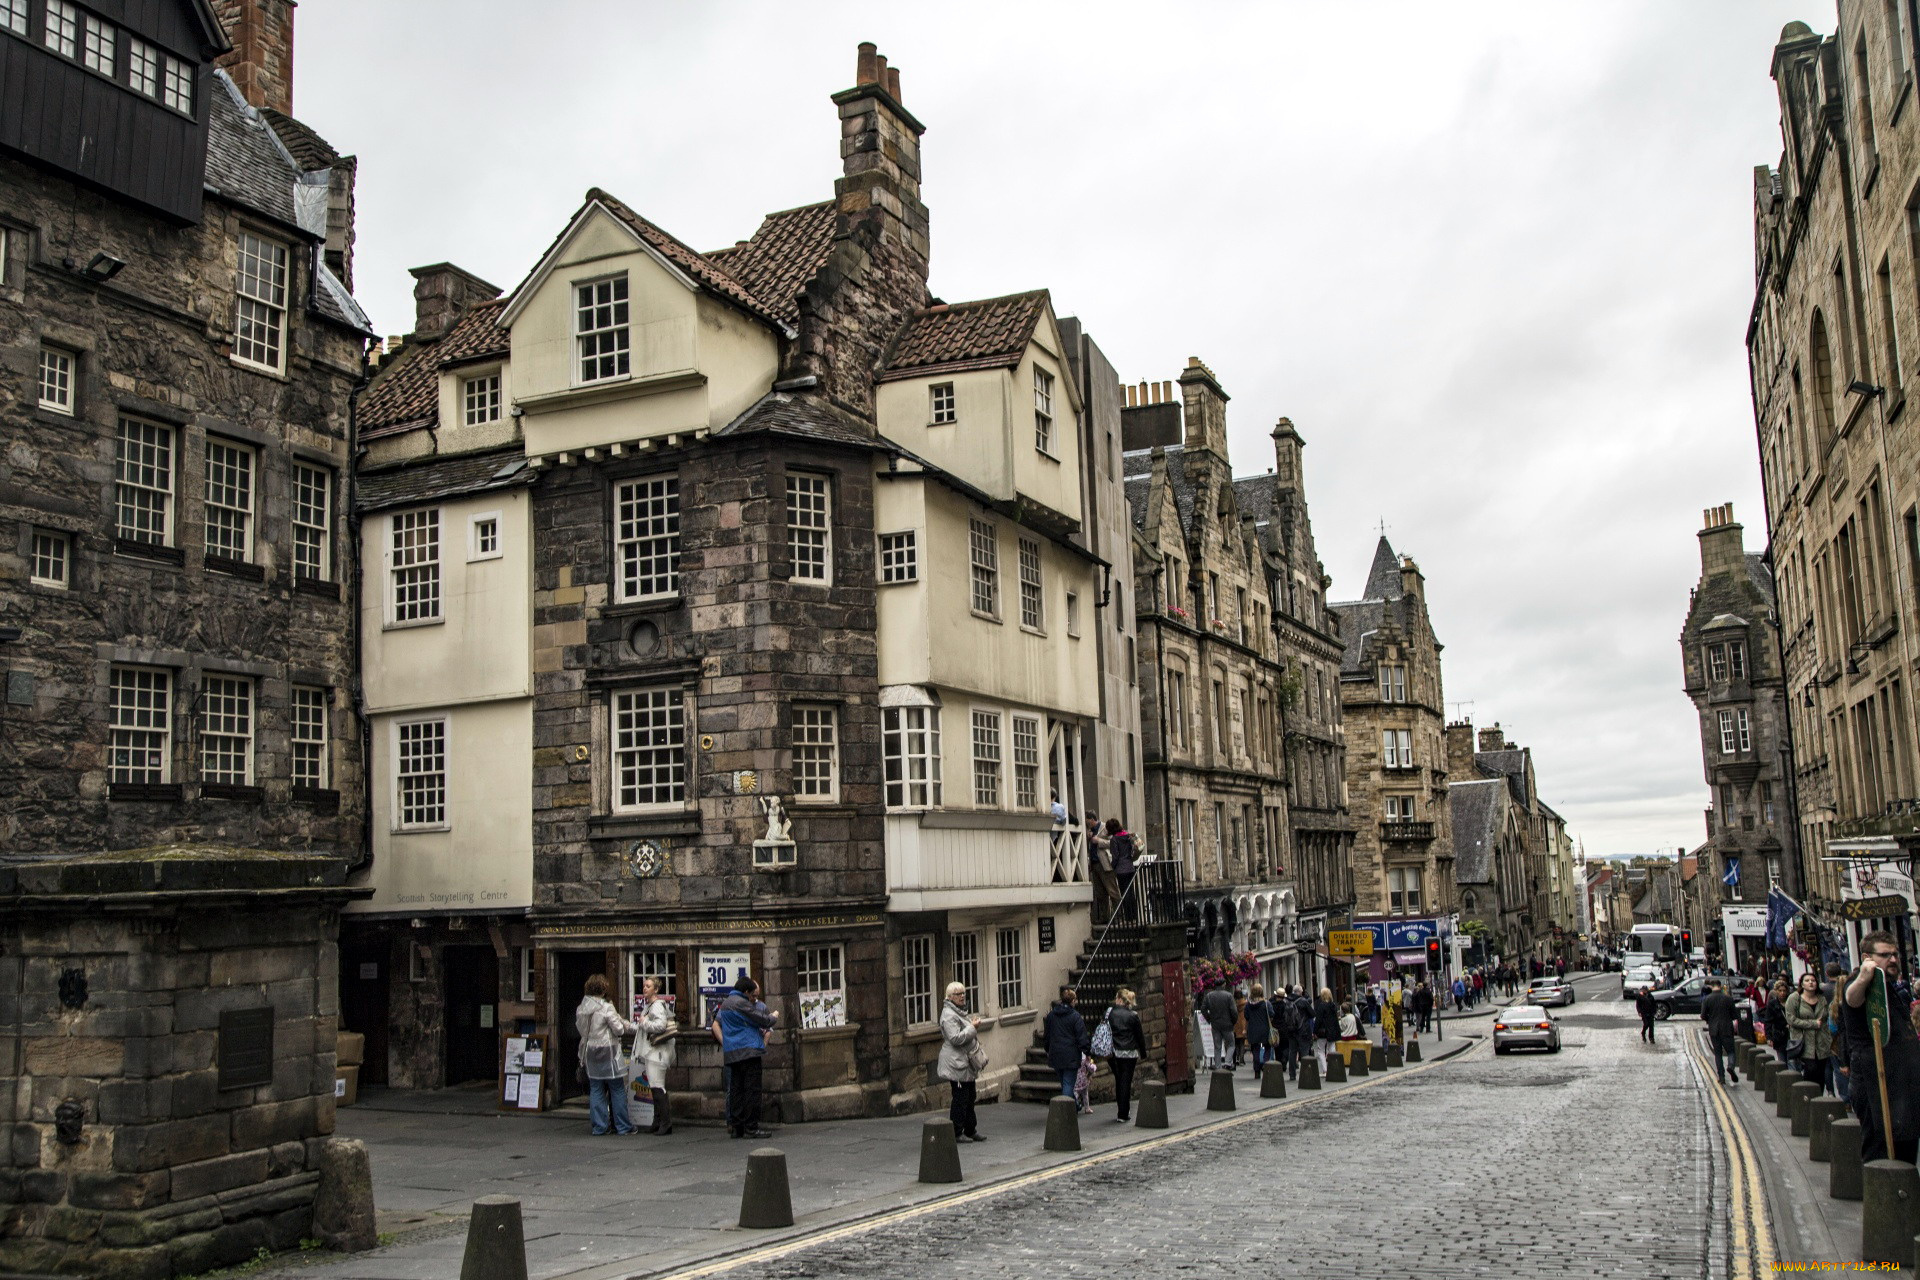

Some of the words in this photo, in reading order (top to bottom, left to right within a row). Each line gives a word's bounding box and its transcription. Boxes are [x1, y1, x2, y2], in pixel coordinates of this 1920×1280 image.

[397, 893, 425, 903] Scottish
[429, 891, 475, 905] Storytelling
[480, 890, 508, 900] Centre
[816, 916, 839, 926] SELF
[707, 966, 727, 985] 30
